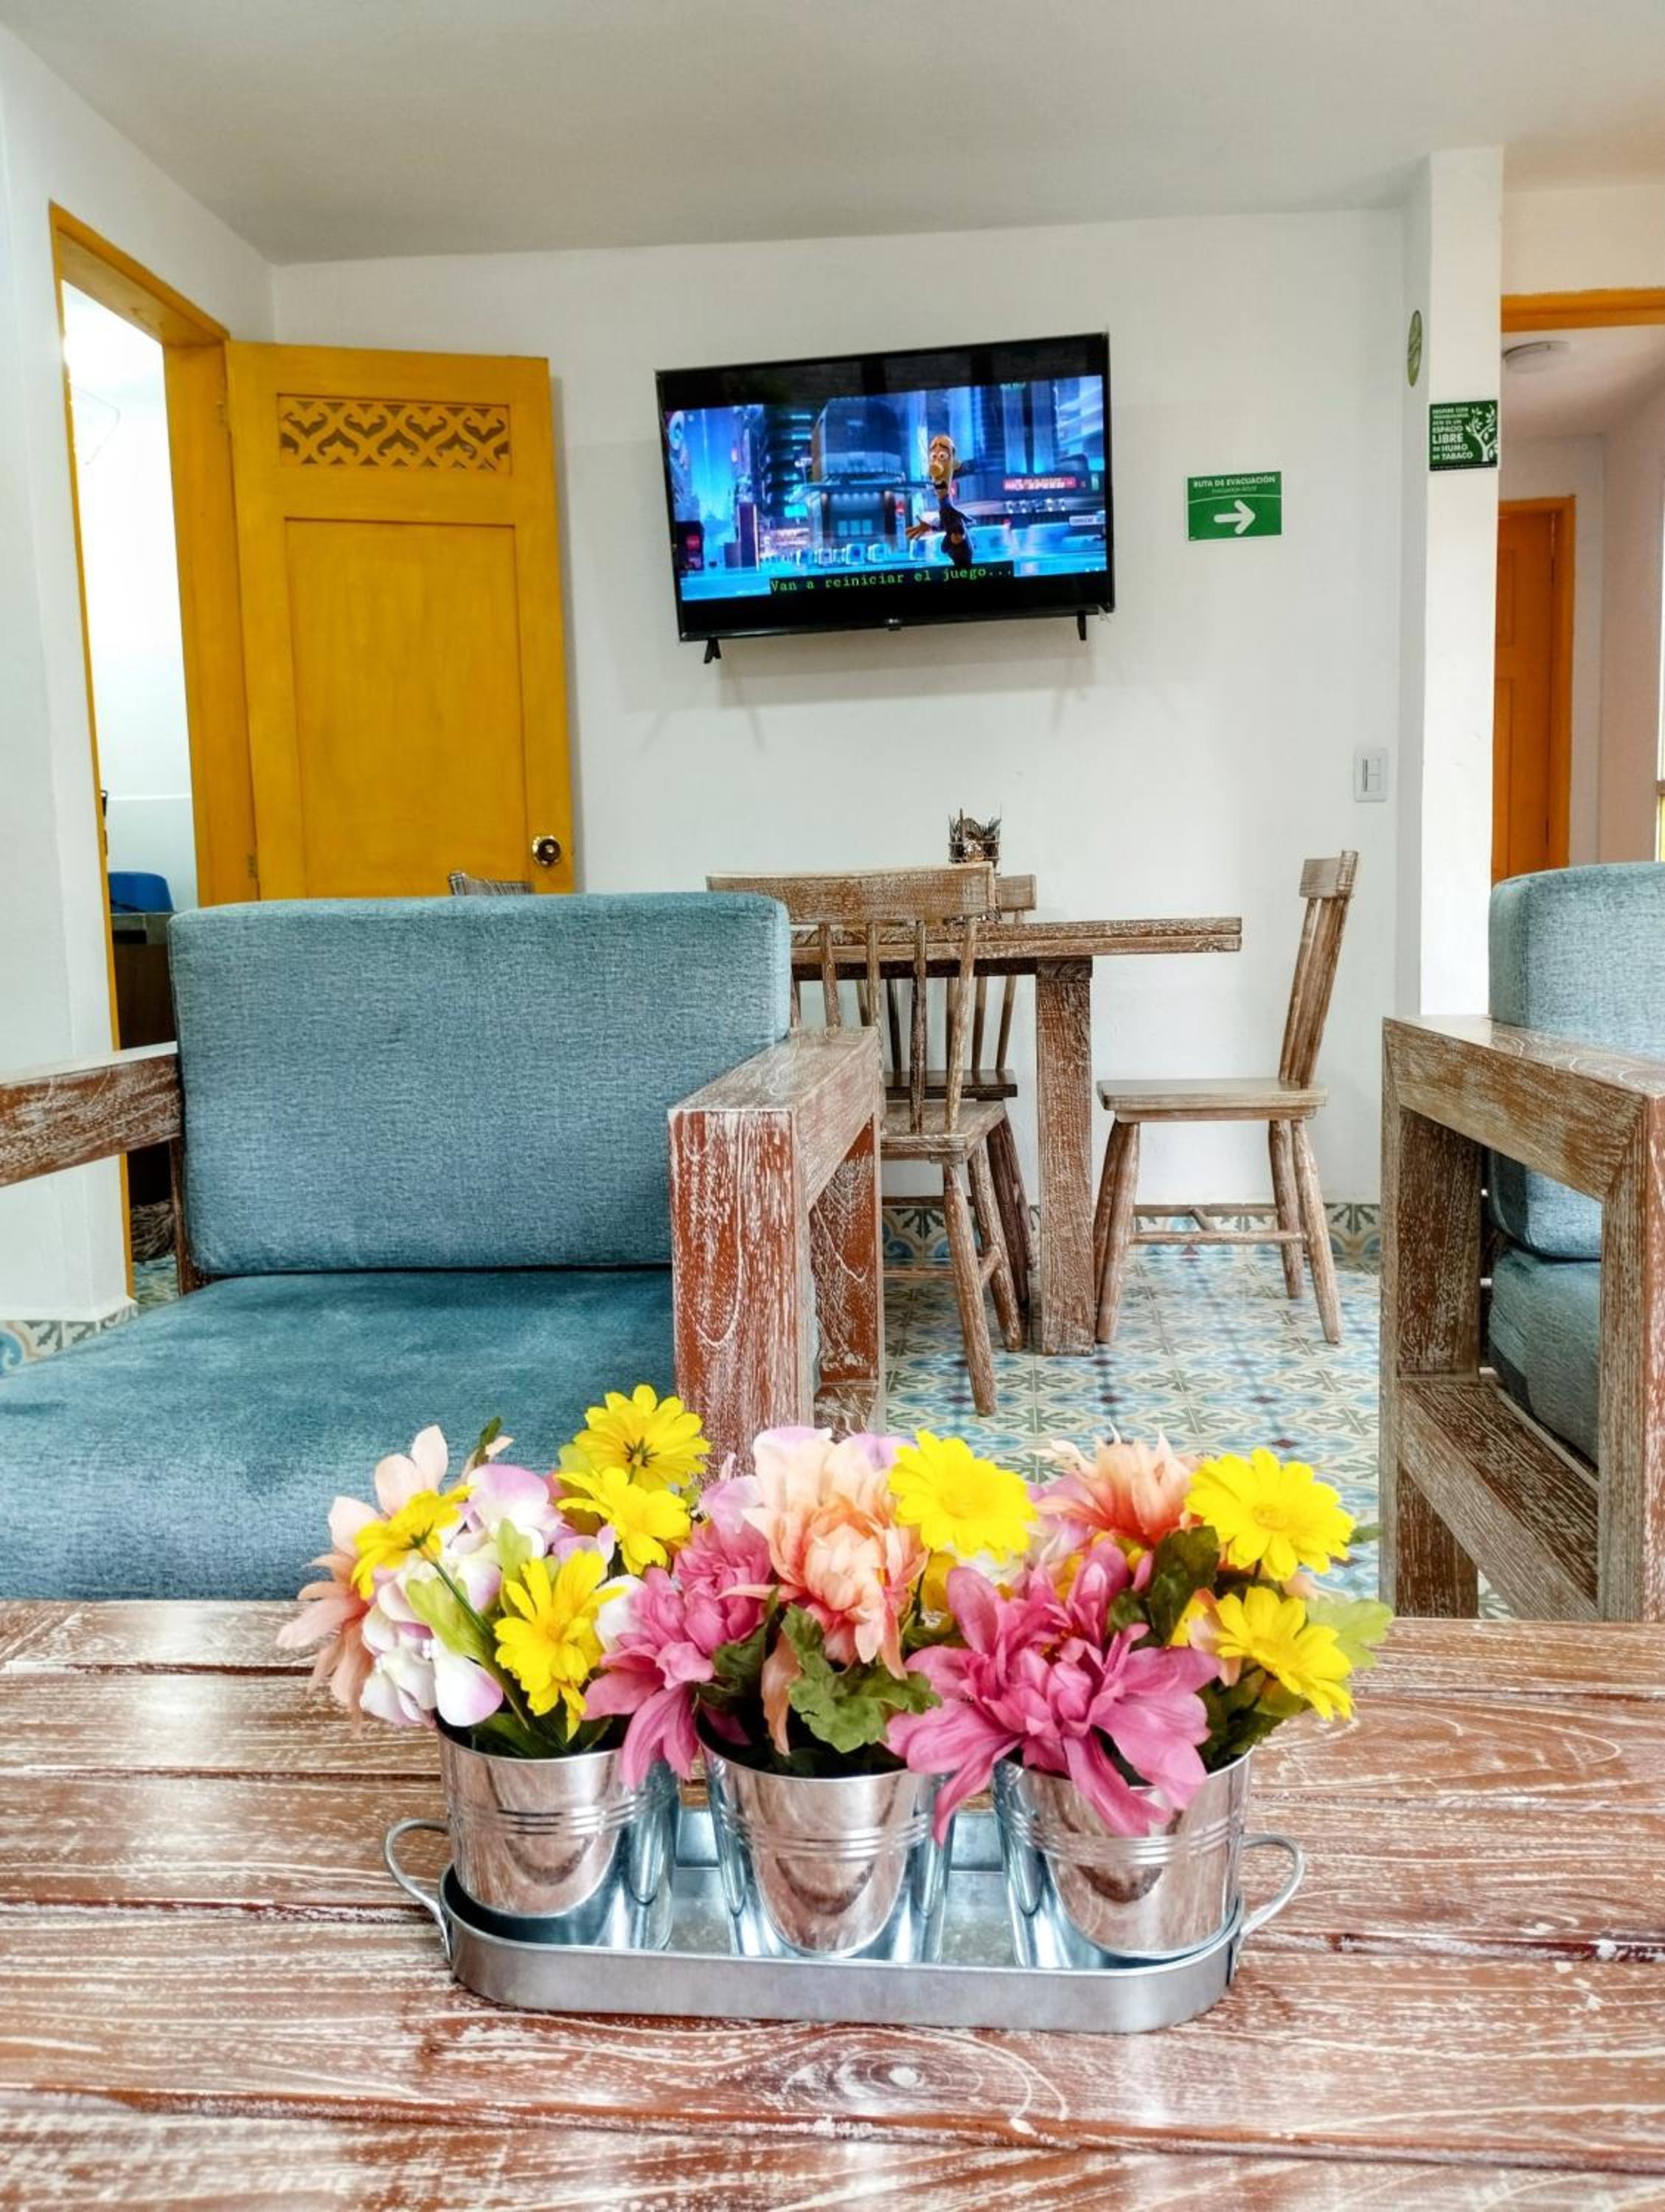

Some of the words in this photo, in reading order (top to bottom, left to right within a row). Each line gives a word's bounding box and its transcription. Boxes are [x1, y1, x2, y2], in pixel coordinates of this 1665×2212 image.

[1433, 434, 1463, 444] LIBRE
[1442, 444, 1468, 452] HUMO
[1442, 451, 1474, 460] TABACO
[1193, 480, 1213, 488] RUTA
[1215, 479, 1224, 487] DE
[771, 580, 797, 592] Van
[806, 581, 815, 590] a
[825, 572, 905, 588] reiniciar
[914, 570, 931, 582] el
[942, 567, 1012, 582] juego...
